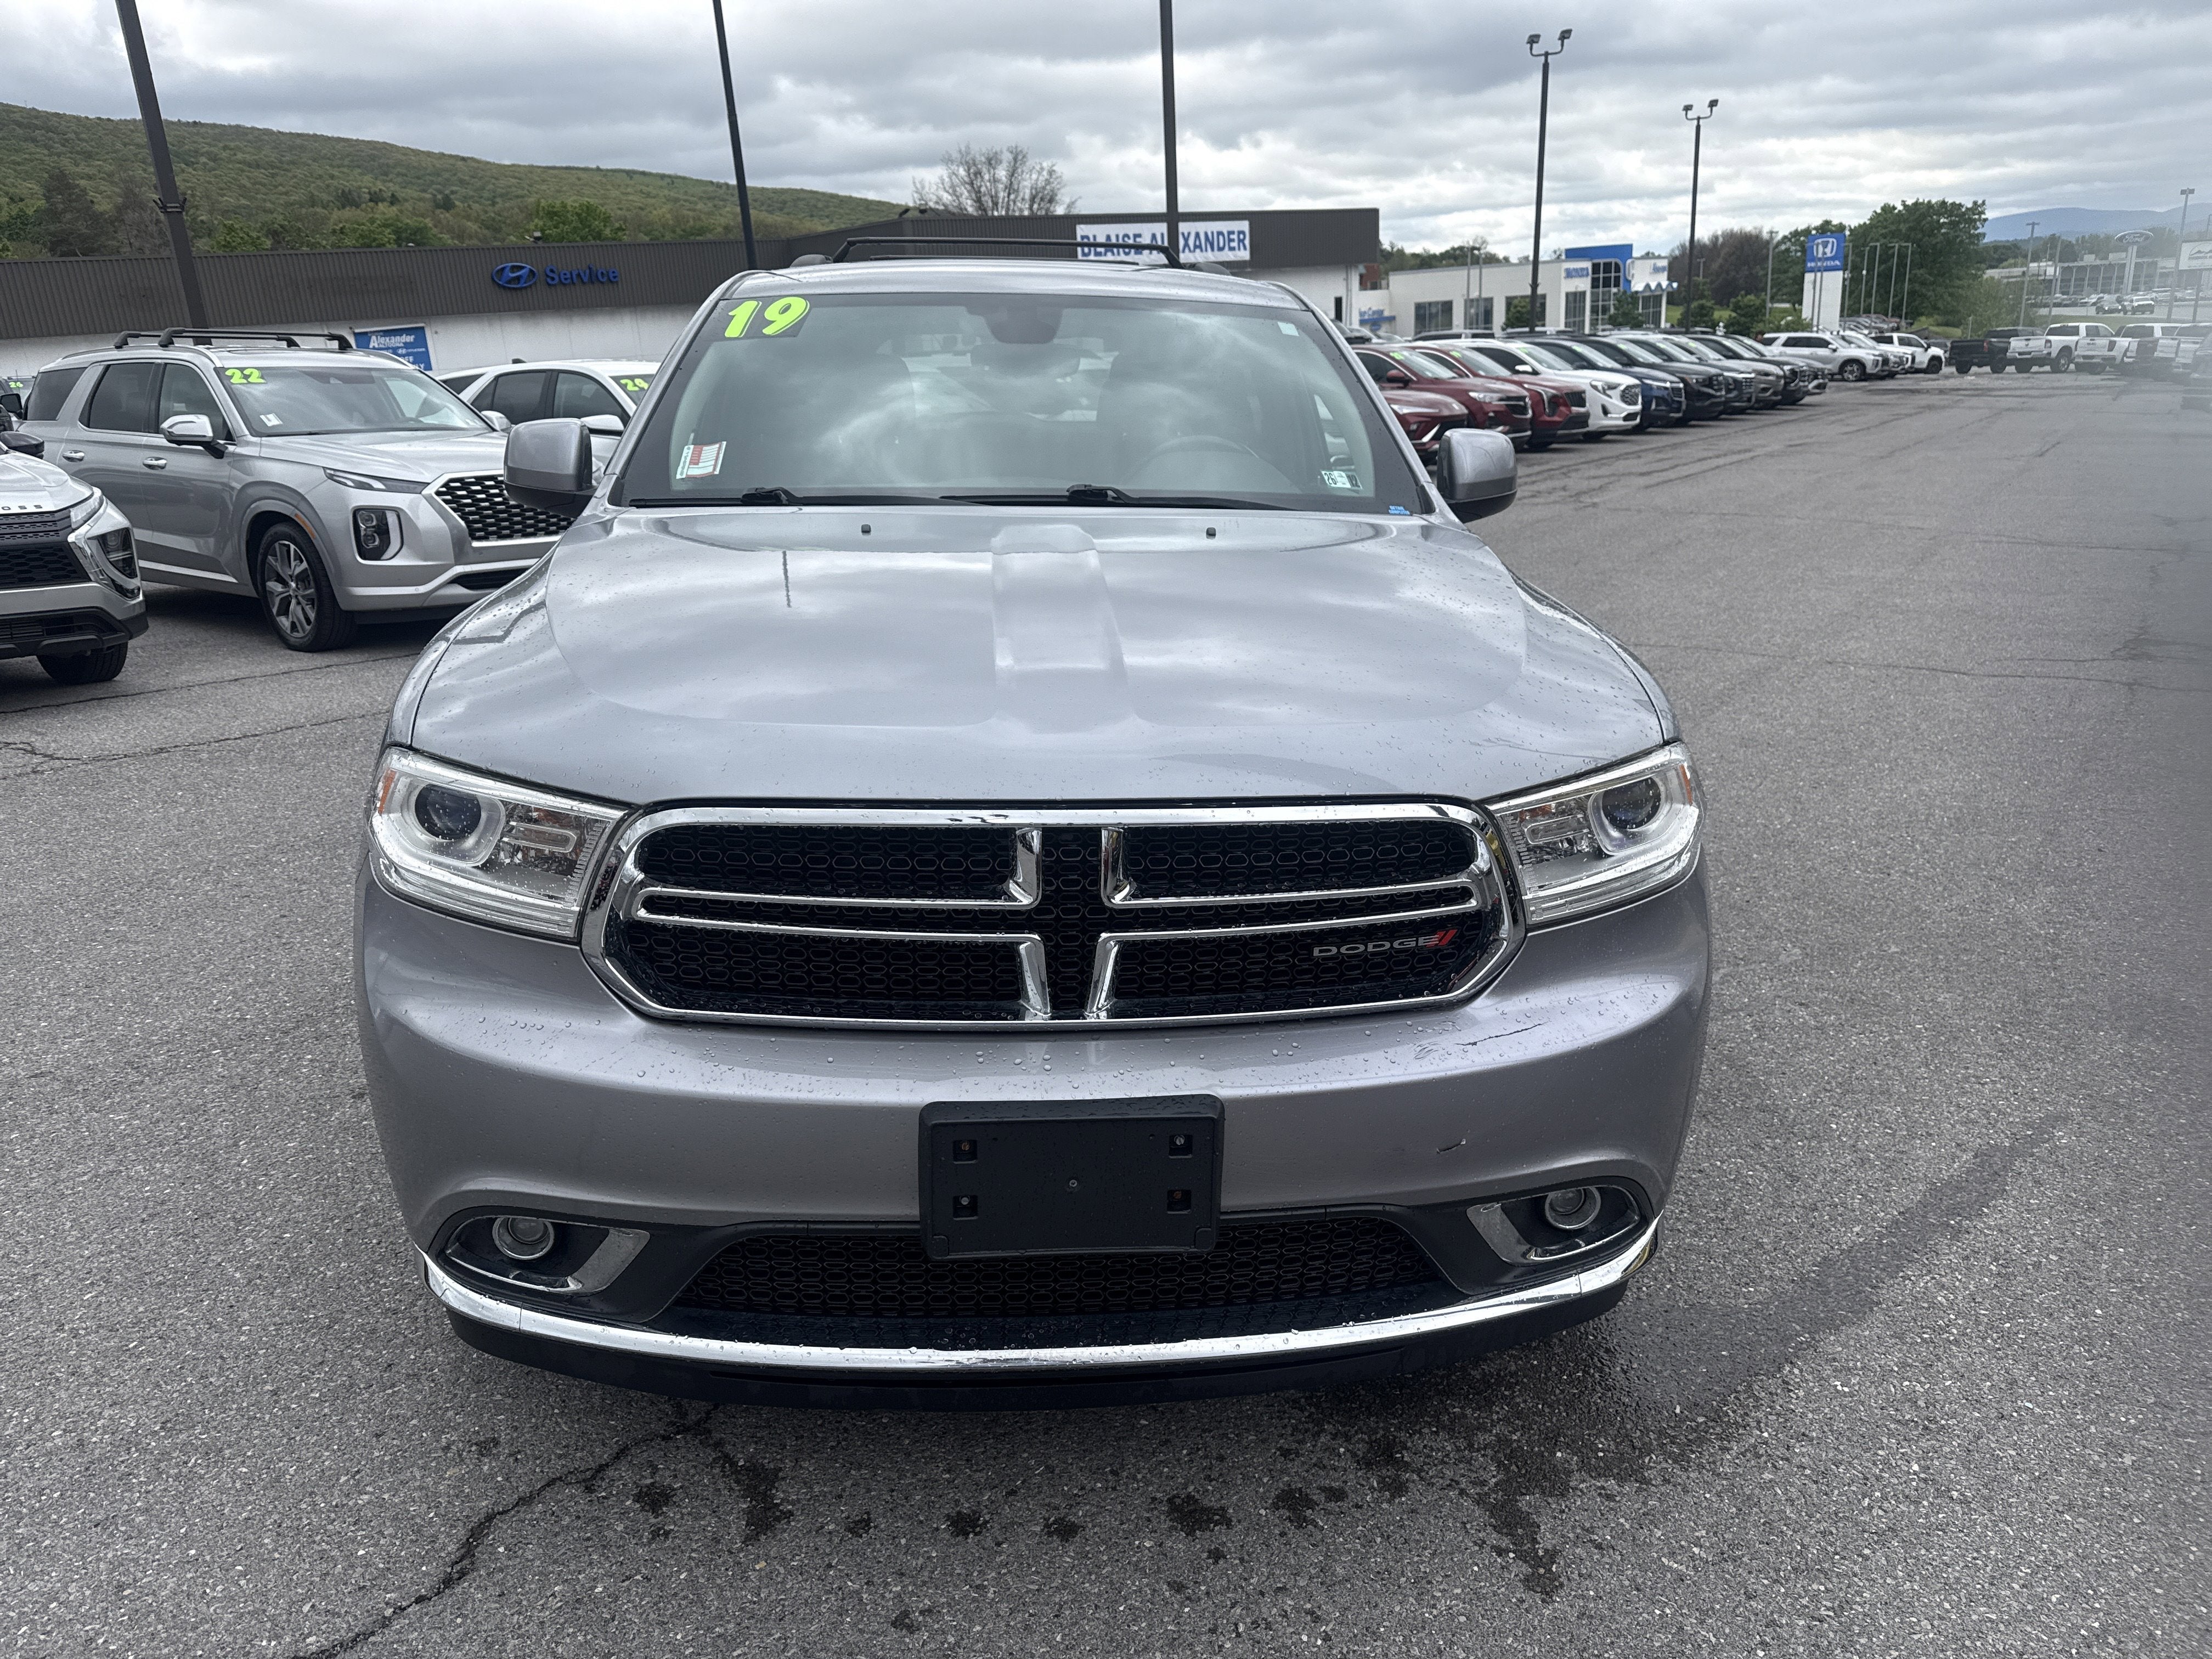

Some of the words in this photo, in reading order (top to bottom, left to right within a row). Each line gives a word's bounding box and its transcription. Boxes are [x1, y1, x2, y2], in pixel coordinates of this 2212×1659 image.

[1080, 233, 1142, 257] BLAISE
[1149, 230, 1247, 255] AXANDER
[2123, 233, 2145, 243] Ford
[545, 263, 619, 285] Service
[725, 297, 810, 337] 19
[369, 334, 415, 348] Alexander
[225, 368, 267, 383] 22
[1324, 472, 1337, 485] 26
[1313, 935, 1440, 956] DODGE
